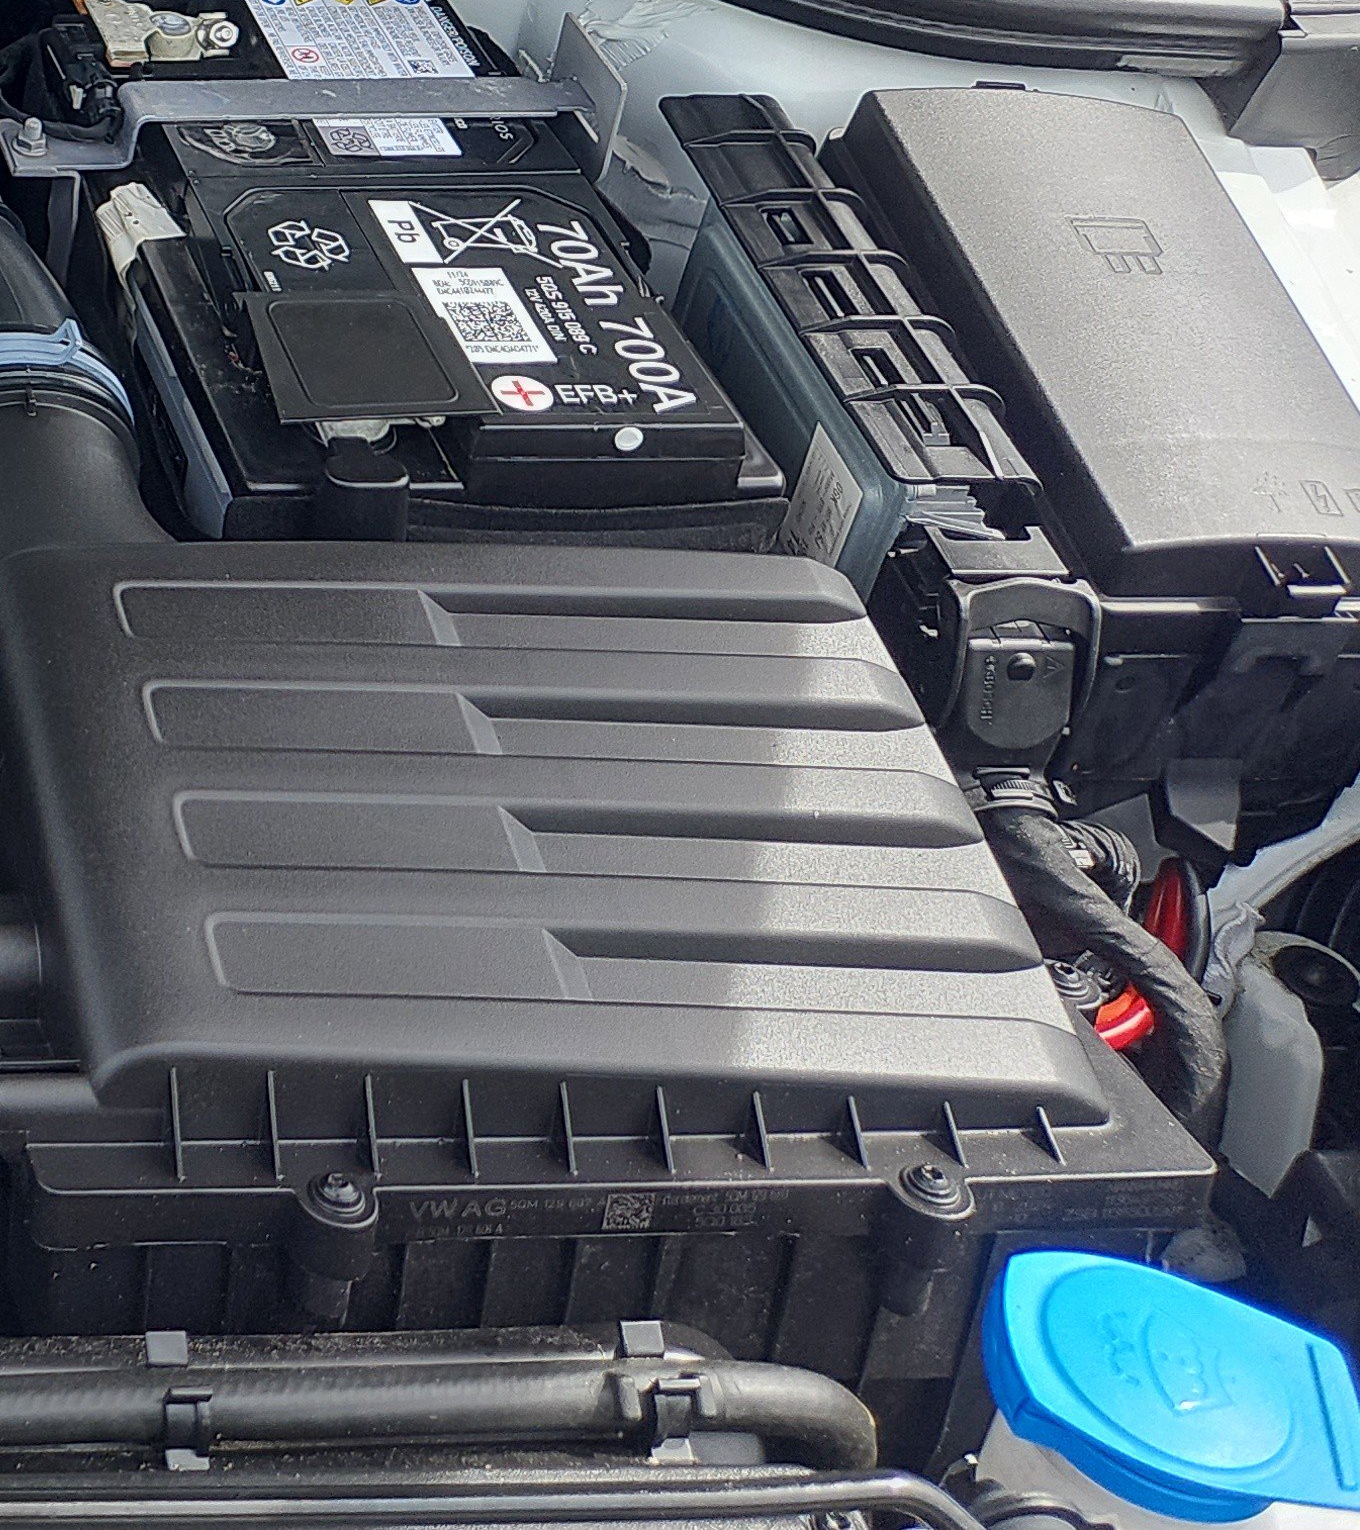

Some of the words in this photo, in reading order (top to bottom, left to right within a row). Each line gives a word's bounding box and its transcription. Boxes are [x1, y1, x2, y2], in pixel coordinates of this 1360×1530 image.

[387, 219, 417, 244] Pb
[536, 220, 625, 306] 70Ah
[598, 316, 699, 415] 700A
[551, 299, 576, 322] 915
[580, 341, 599, 357] C
[553, 383, 639, 406] EFB+
[409, 1197, 459, 1219] VW
[461, 1197, 507, 1218] AG
